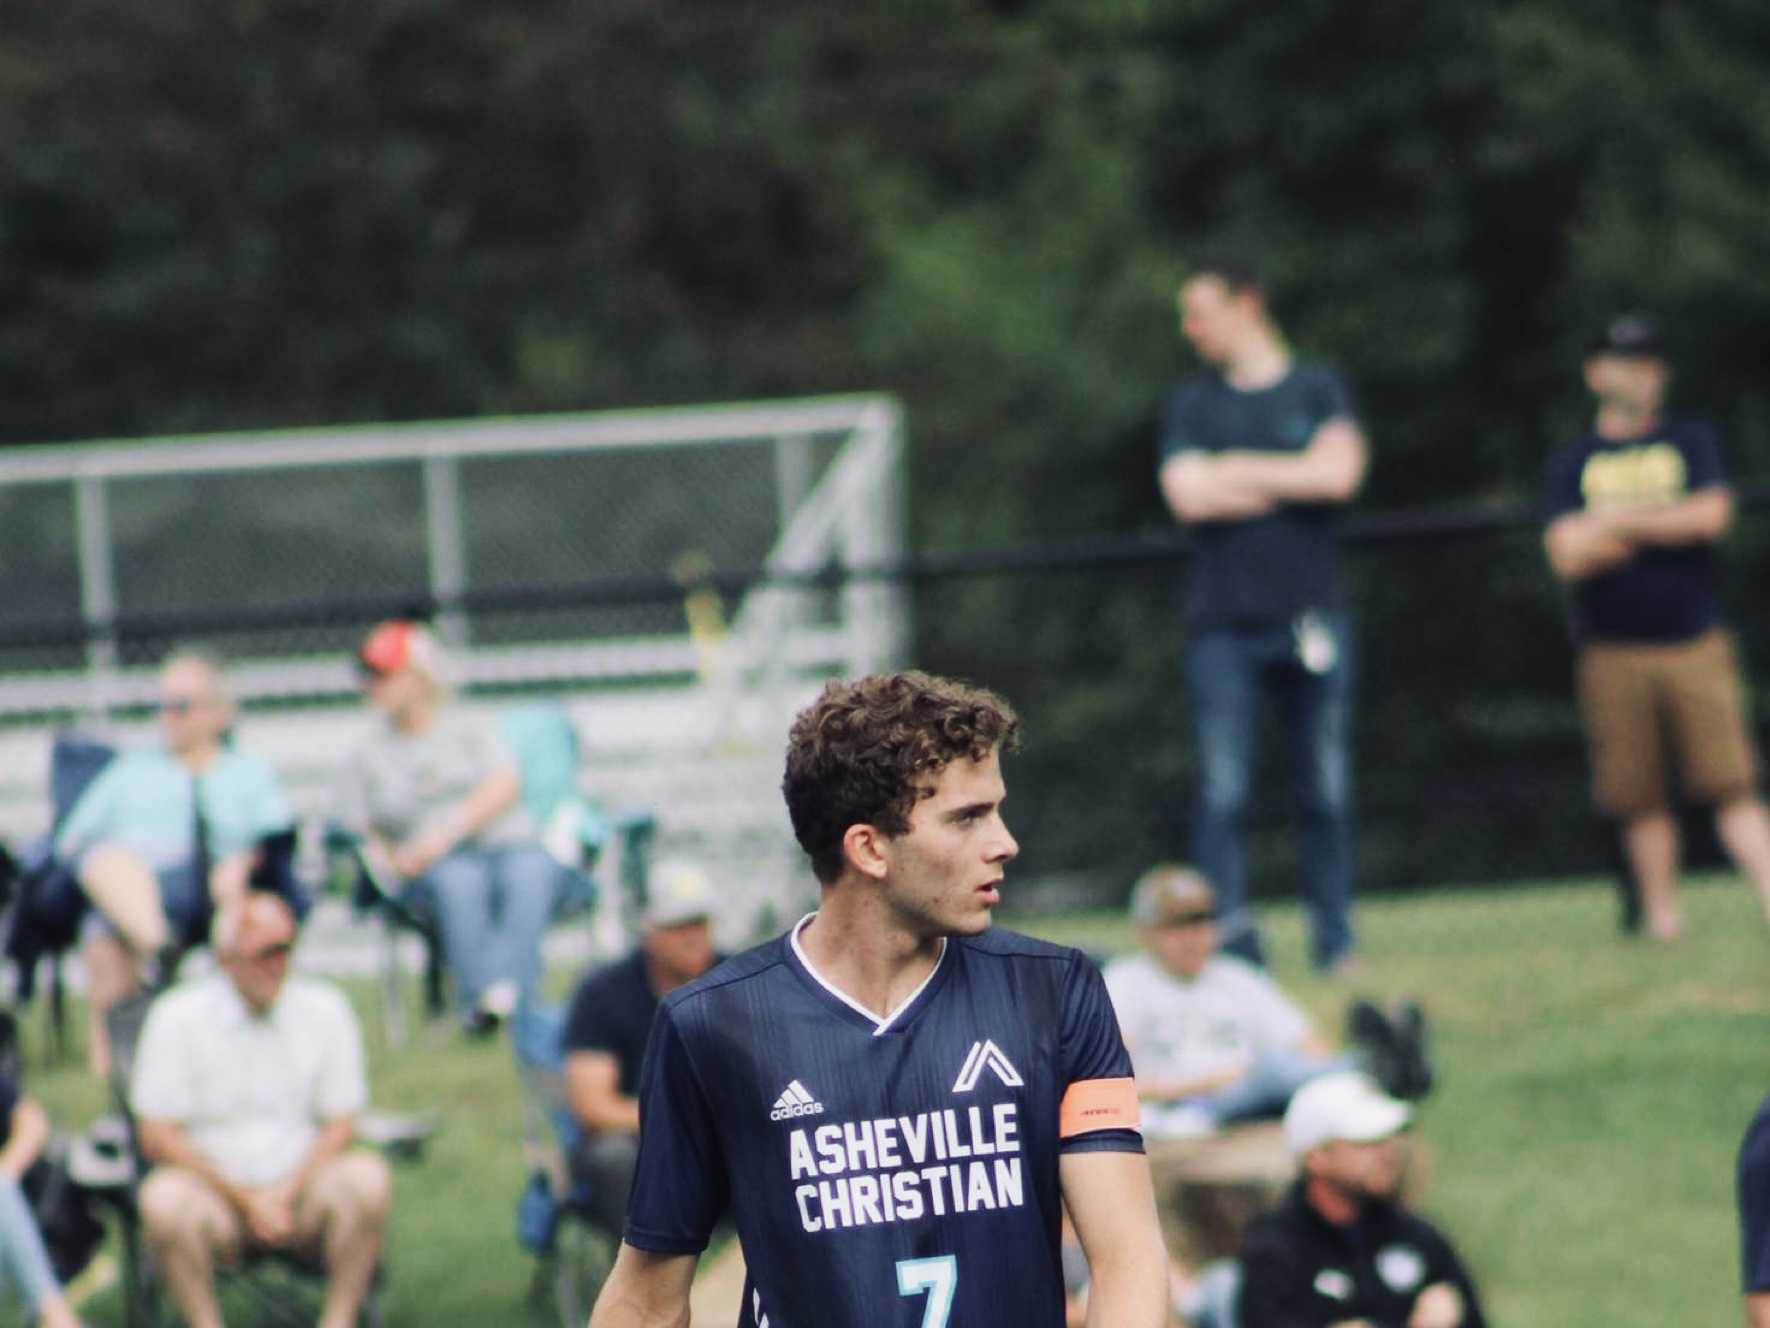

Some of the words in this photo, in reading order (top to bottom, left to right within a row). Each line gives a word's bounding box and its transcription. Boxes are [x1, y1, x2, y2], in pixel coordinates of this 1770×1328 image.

[770, 1102, 824, 1121] adidas
[790, 1103, 1021, 1180] ASHEVILLE
[795, 1157, 1023, 1233] CHRISTIAN
